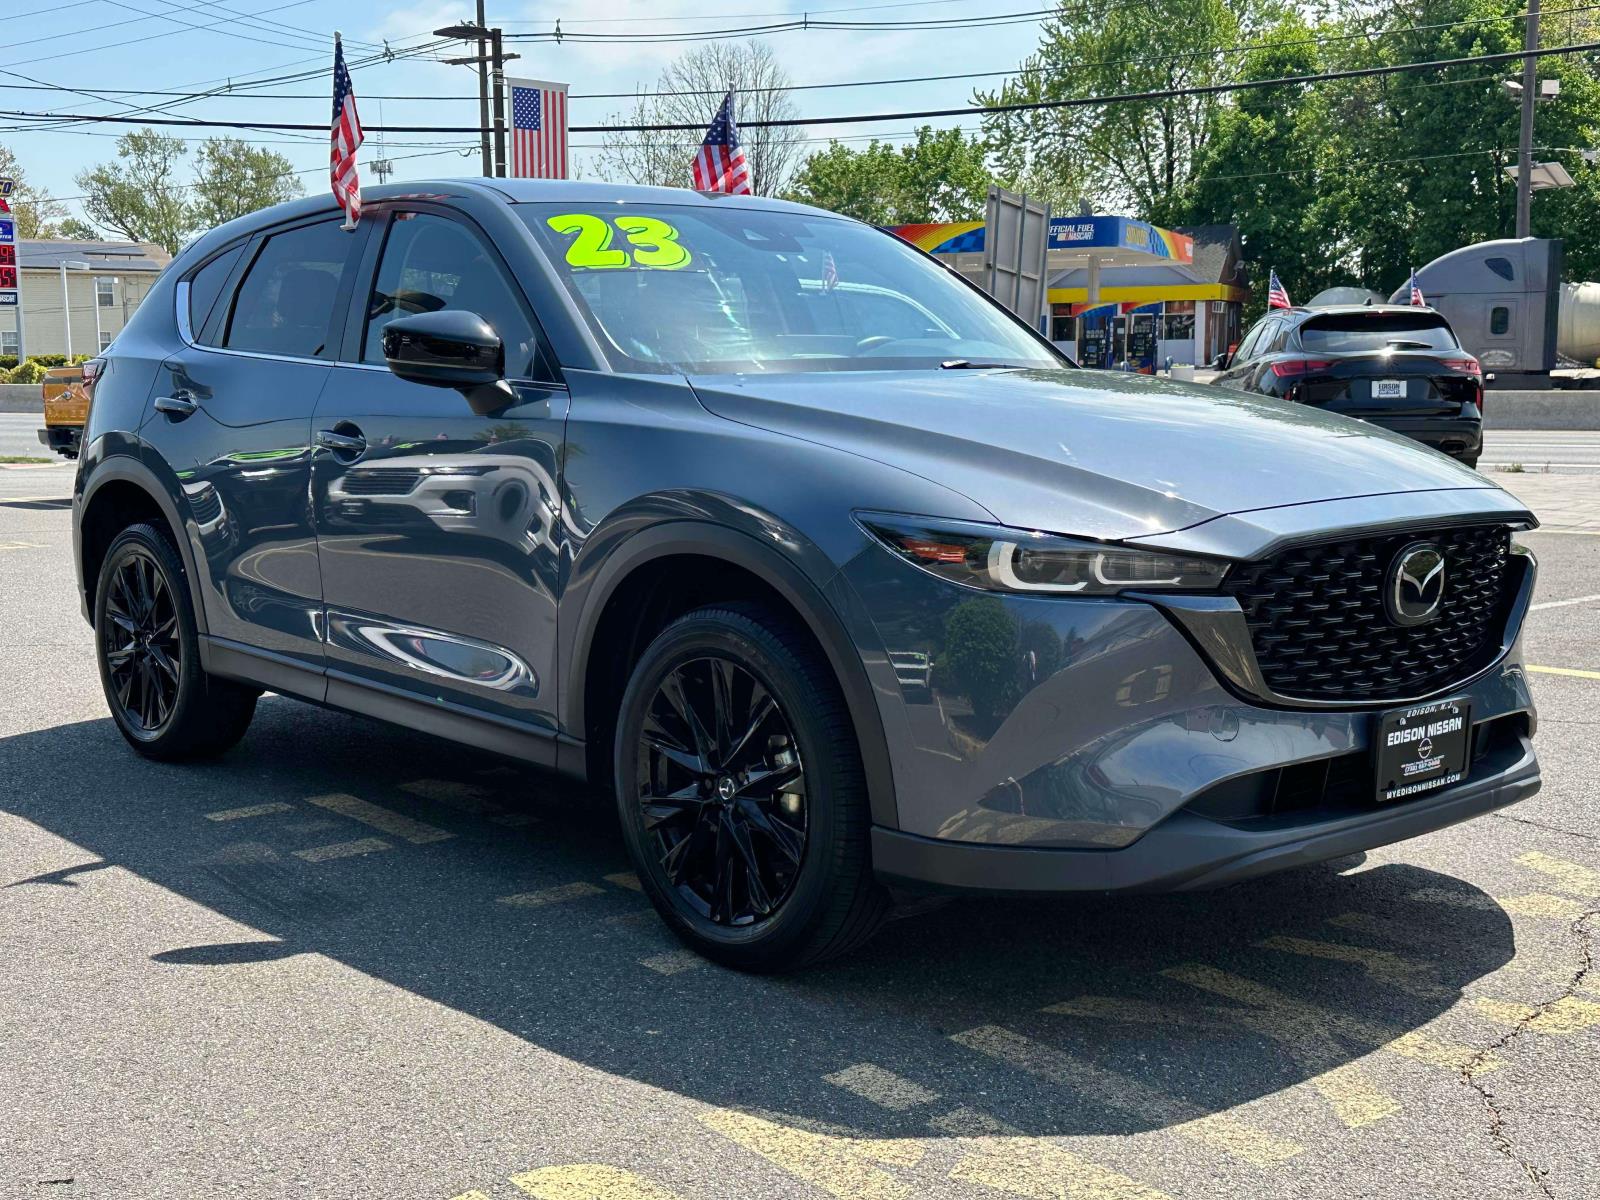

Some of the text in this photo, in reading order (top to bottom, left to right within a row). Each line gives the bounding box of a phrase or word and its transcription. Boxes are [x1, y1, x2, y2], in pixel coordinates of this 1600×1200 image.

[1049, 223, 1095, 234] FFICIAL FUEL
[546, 213, 692, 270] 23
[1407, 706, 1437, 717] EDISON,
[1387, 717, 1463, 746] EDISON NISSAN
[1386, 774, 1461, 799] MYEDISONNISSAN.COM
